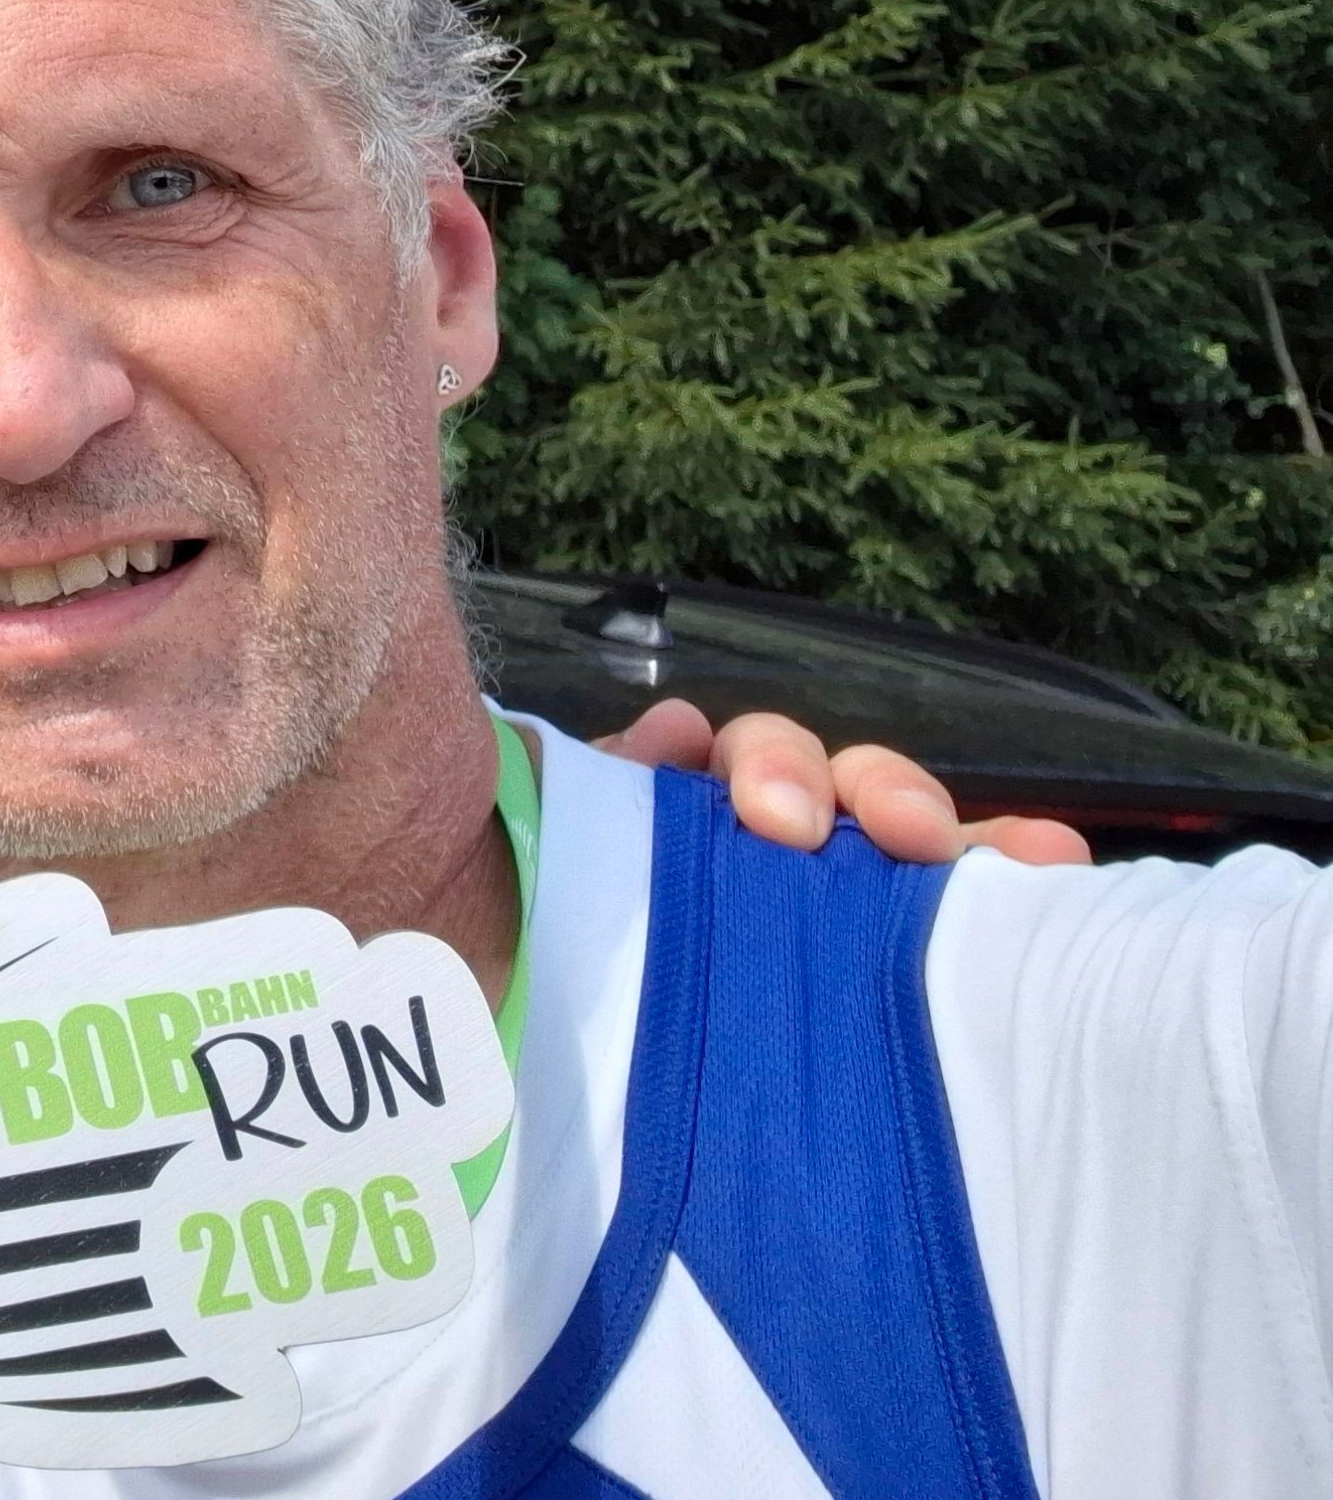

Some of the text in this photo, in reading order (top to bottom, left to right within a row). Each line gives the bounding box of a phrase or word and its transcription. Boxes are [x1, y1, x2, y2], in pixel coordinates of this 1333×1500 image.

[196, 969, 320, 1028] BAHN
[191, 995, 447, 1162] RUN
[178, 1174, 437, 1318] 2026
